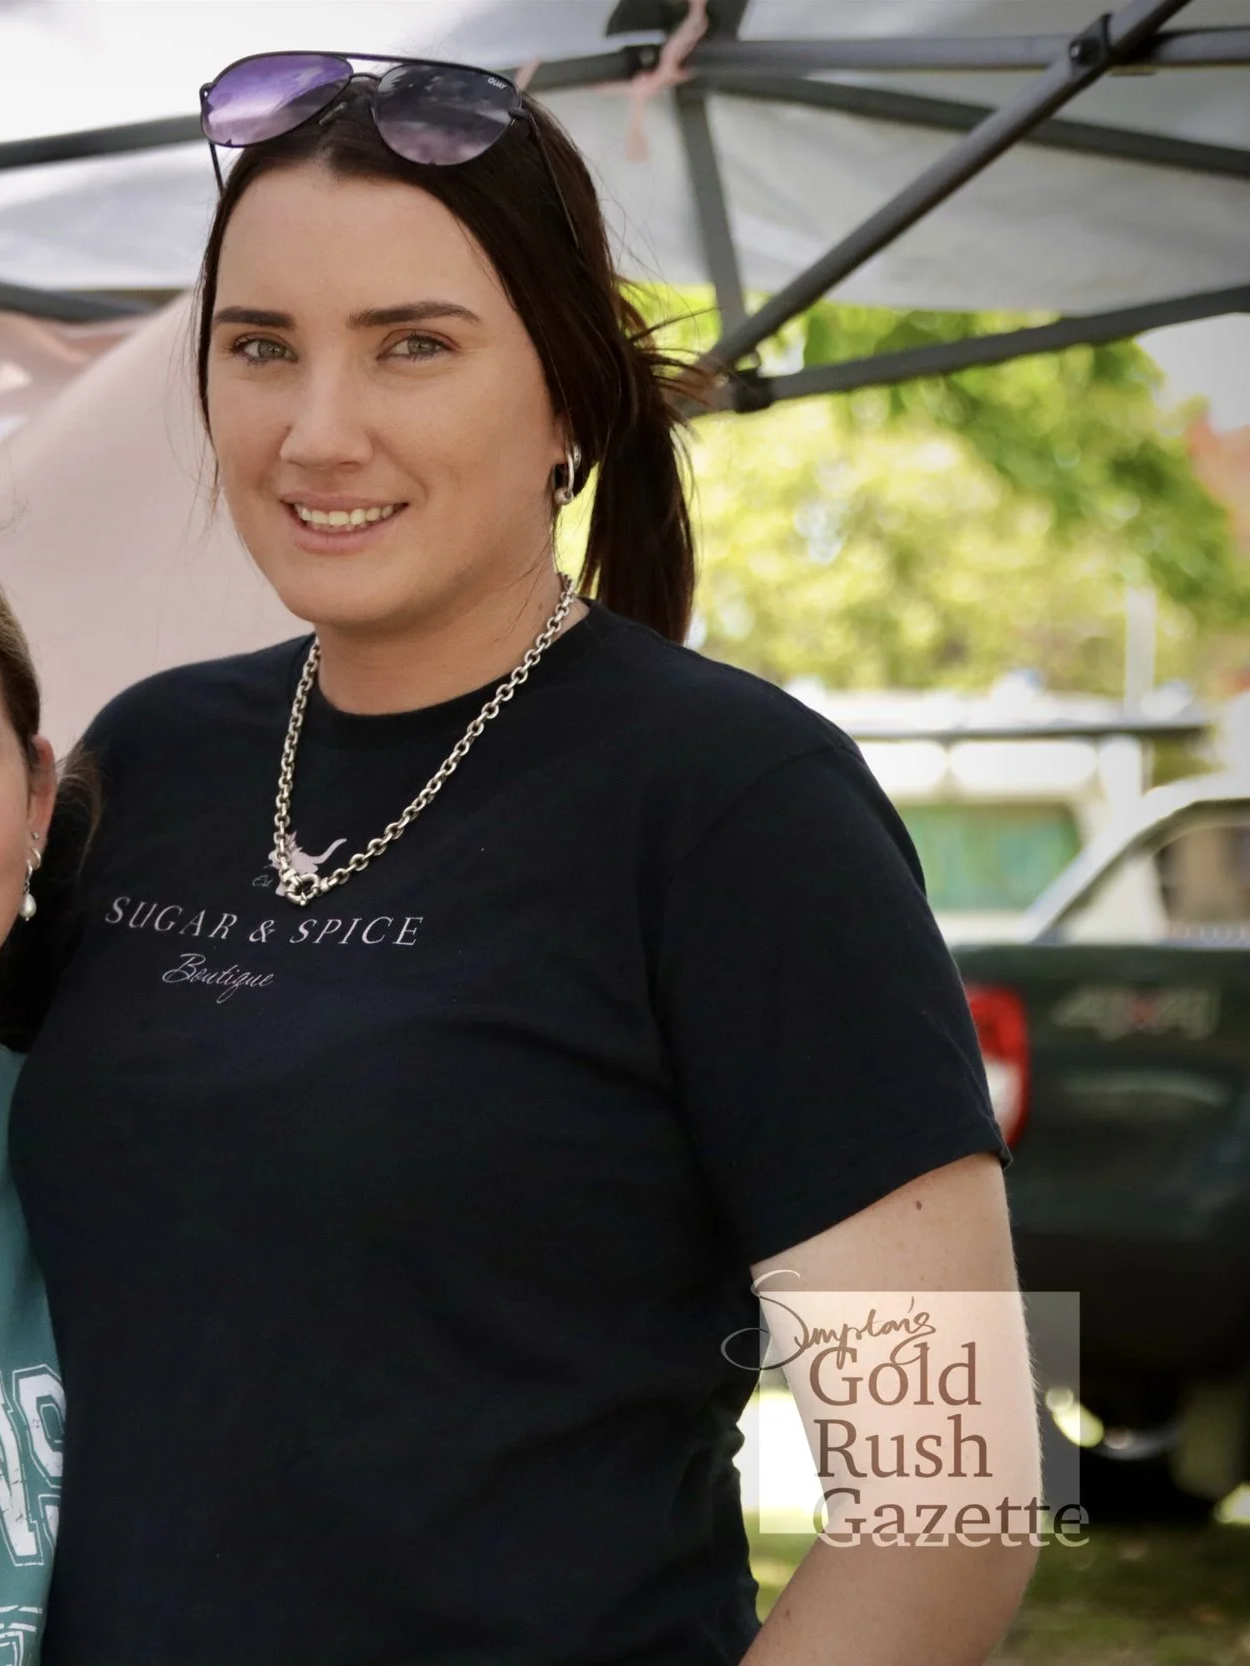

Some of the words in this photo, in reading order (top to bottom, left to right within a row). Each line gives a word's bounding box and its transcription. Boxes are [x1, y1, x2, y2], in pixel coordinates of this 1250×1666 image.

[487, 77, 508, 90] QUAY
[105, 896, 238, 940] SUGAR
[249, 919, 277, 944] &
[289, 916, 424, 947] SPICE
[162, 952, 274, 1004] Boutique
